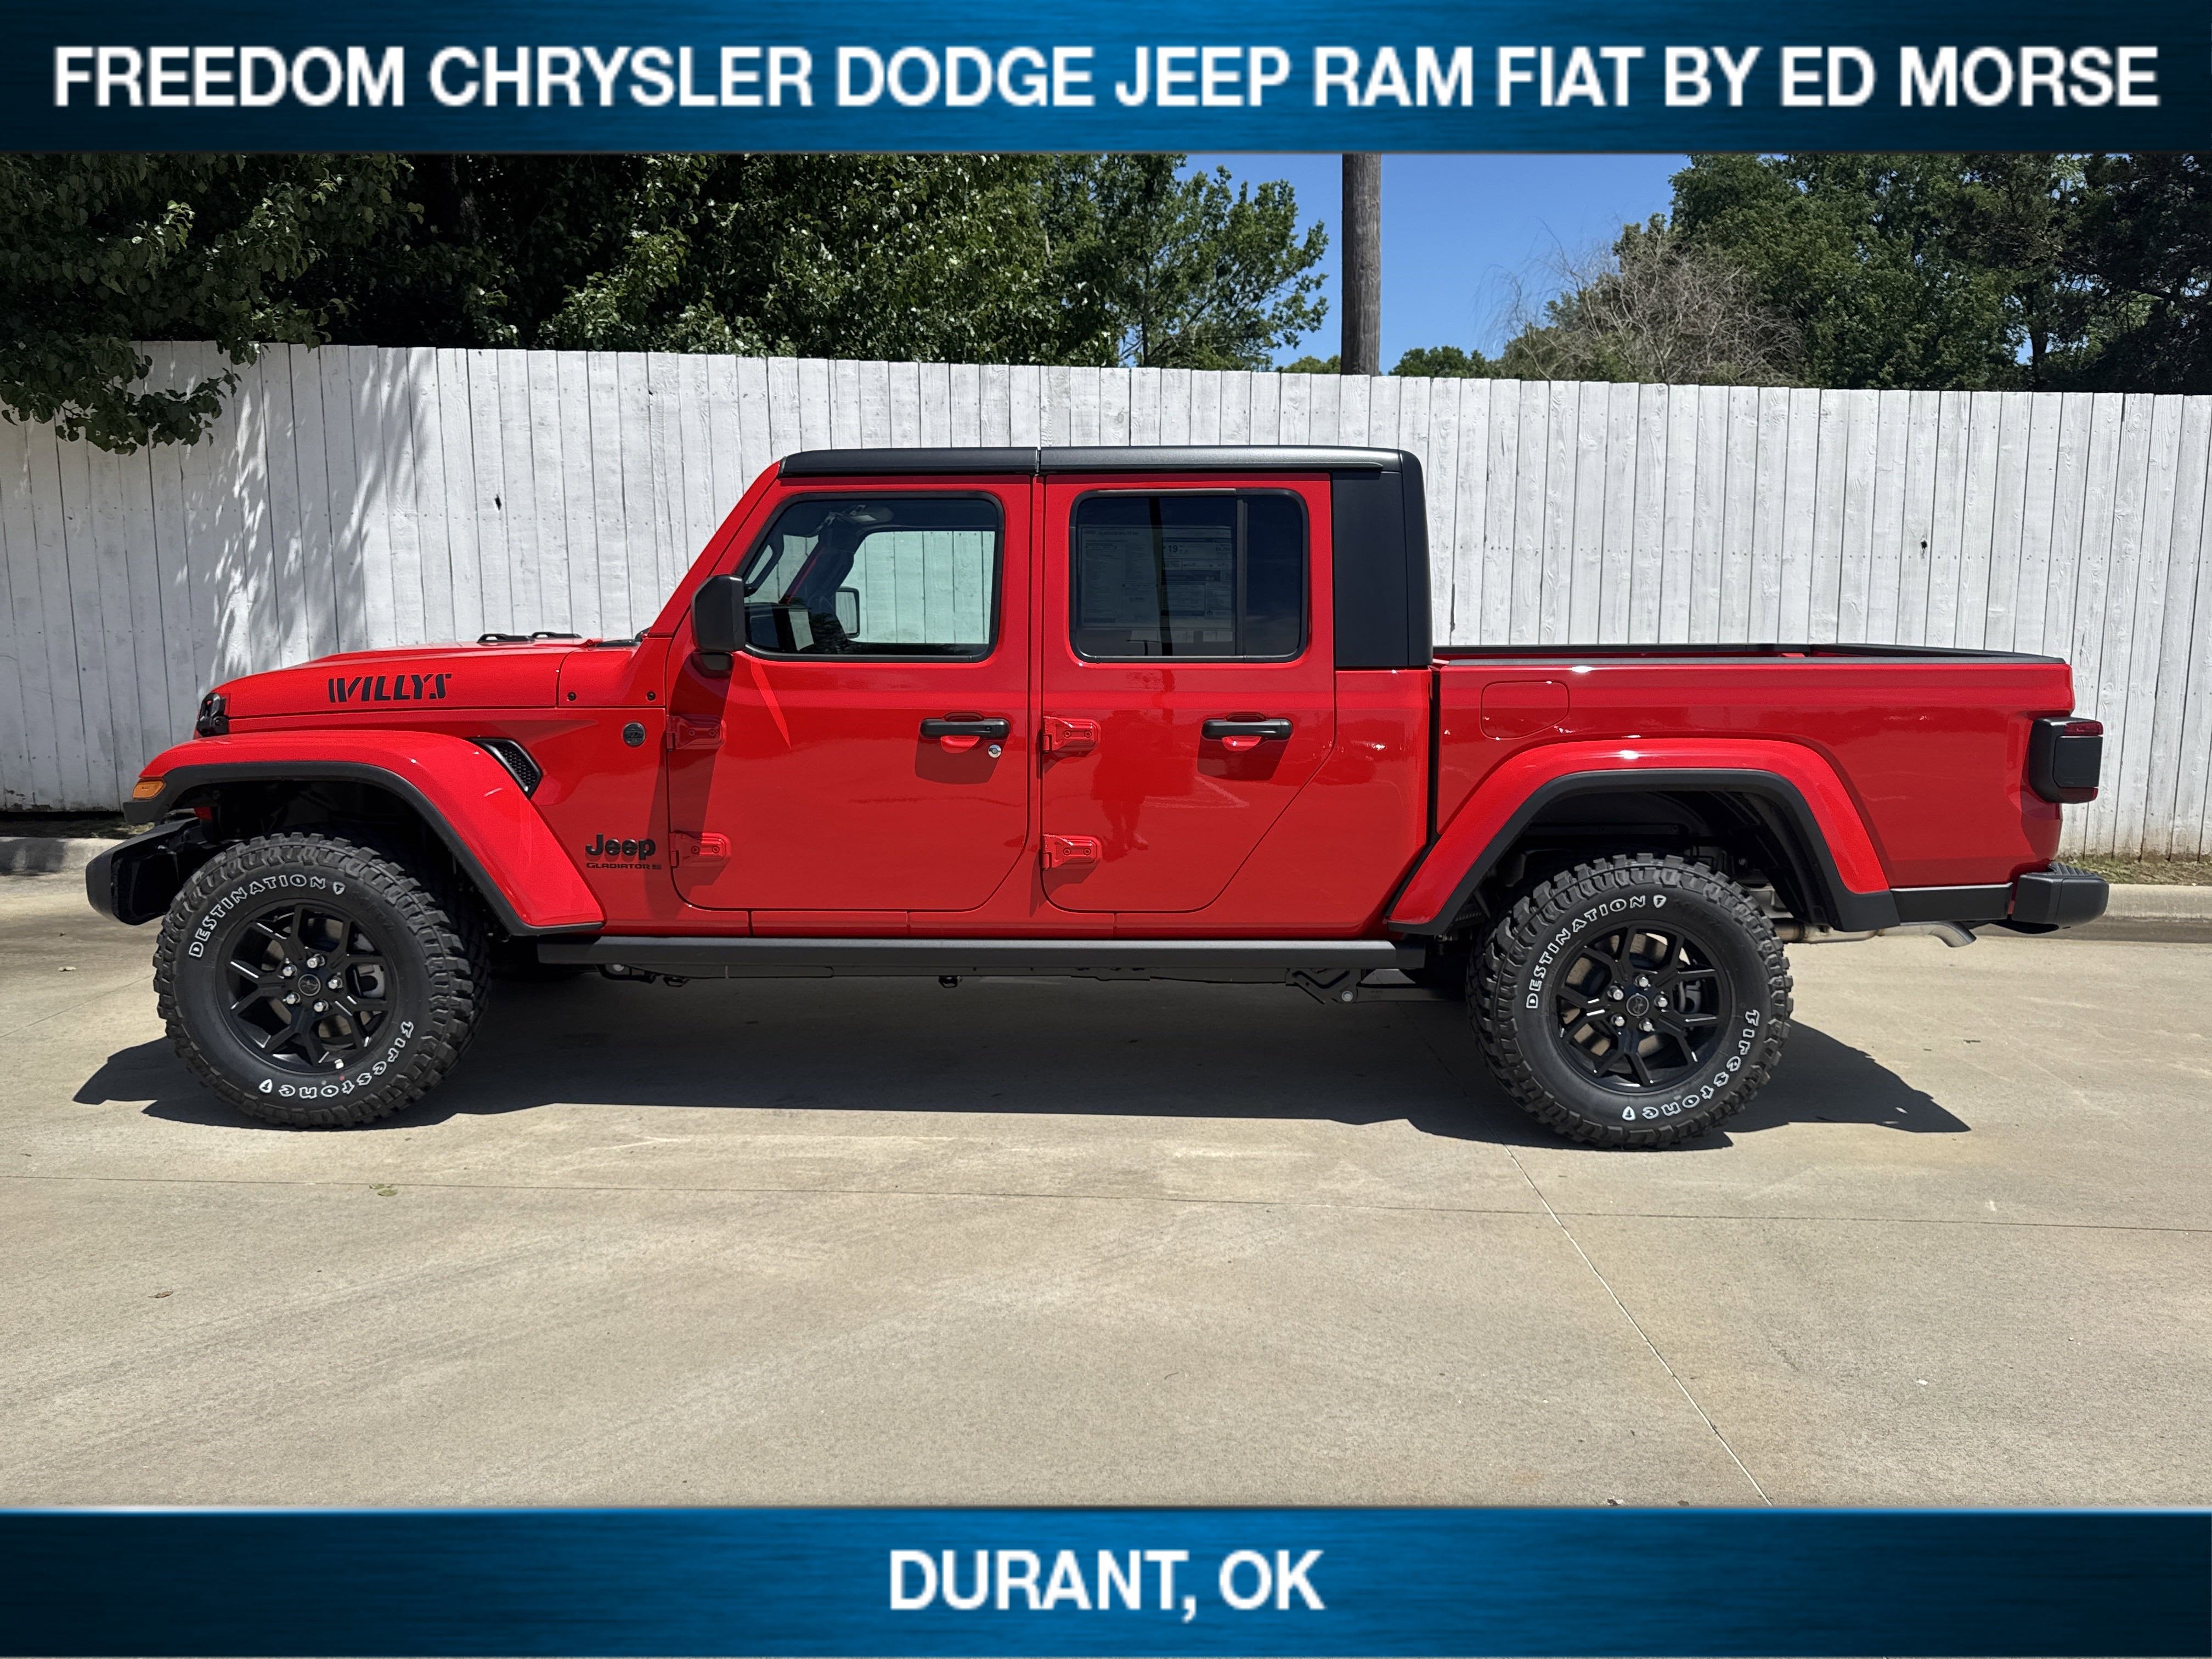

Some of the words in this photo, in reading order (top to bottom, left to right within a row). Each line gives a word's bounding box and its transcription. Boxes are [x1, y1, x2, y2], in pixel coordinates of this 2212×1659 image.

[328, 673, 452, 703] WILLYS
[585, 833, 656, 861] Jeep
[188, 874, 326, 958] DESTINATION
[1526, 895, 1646, 1009] DESTINATION
